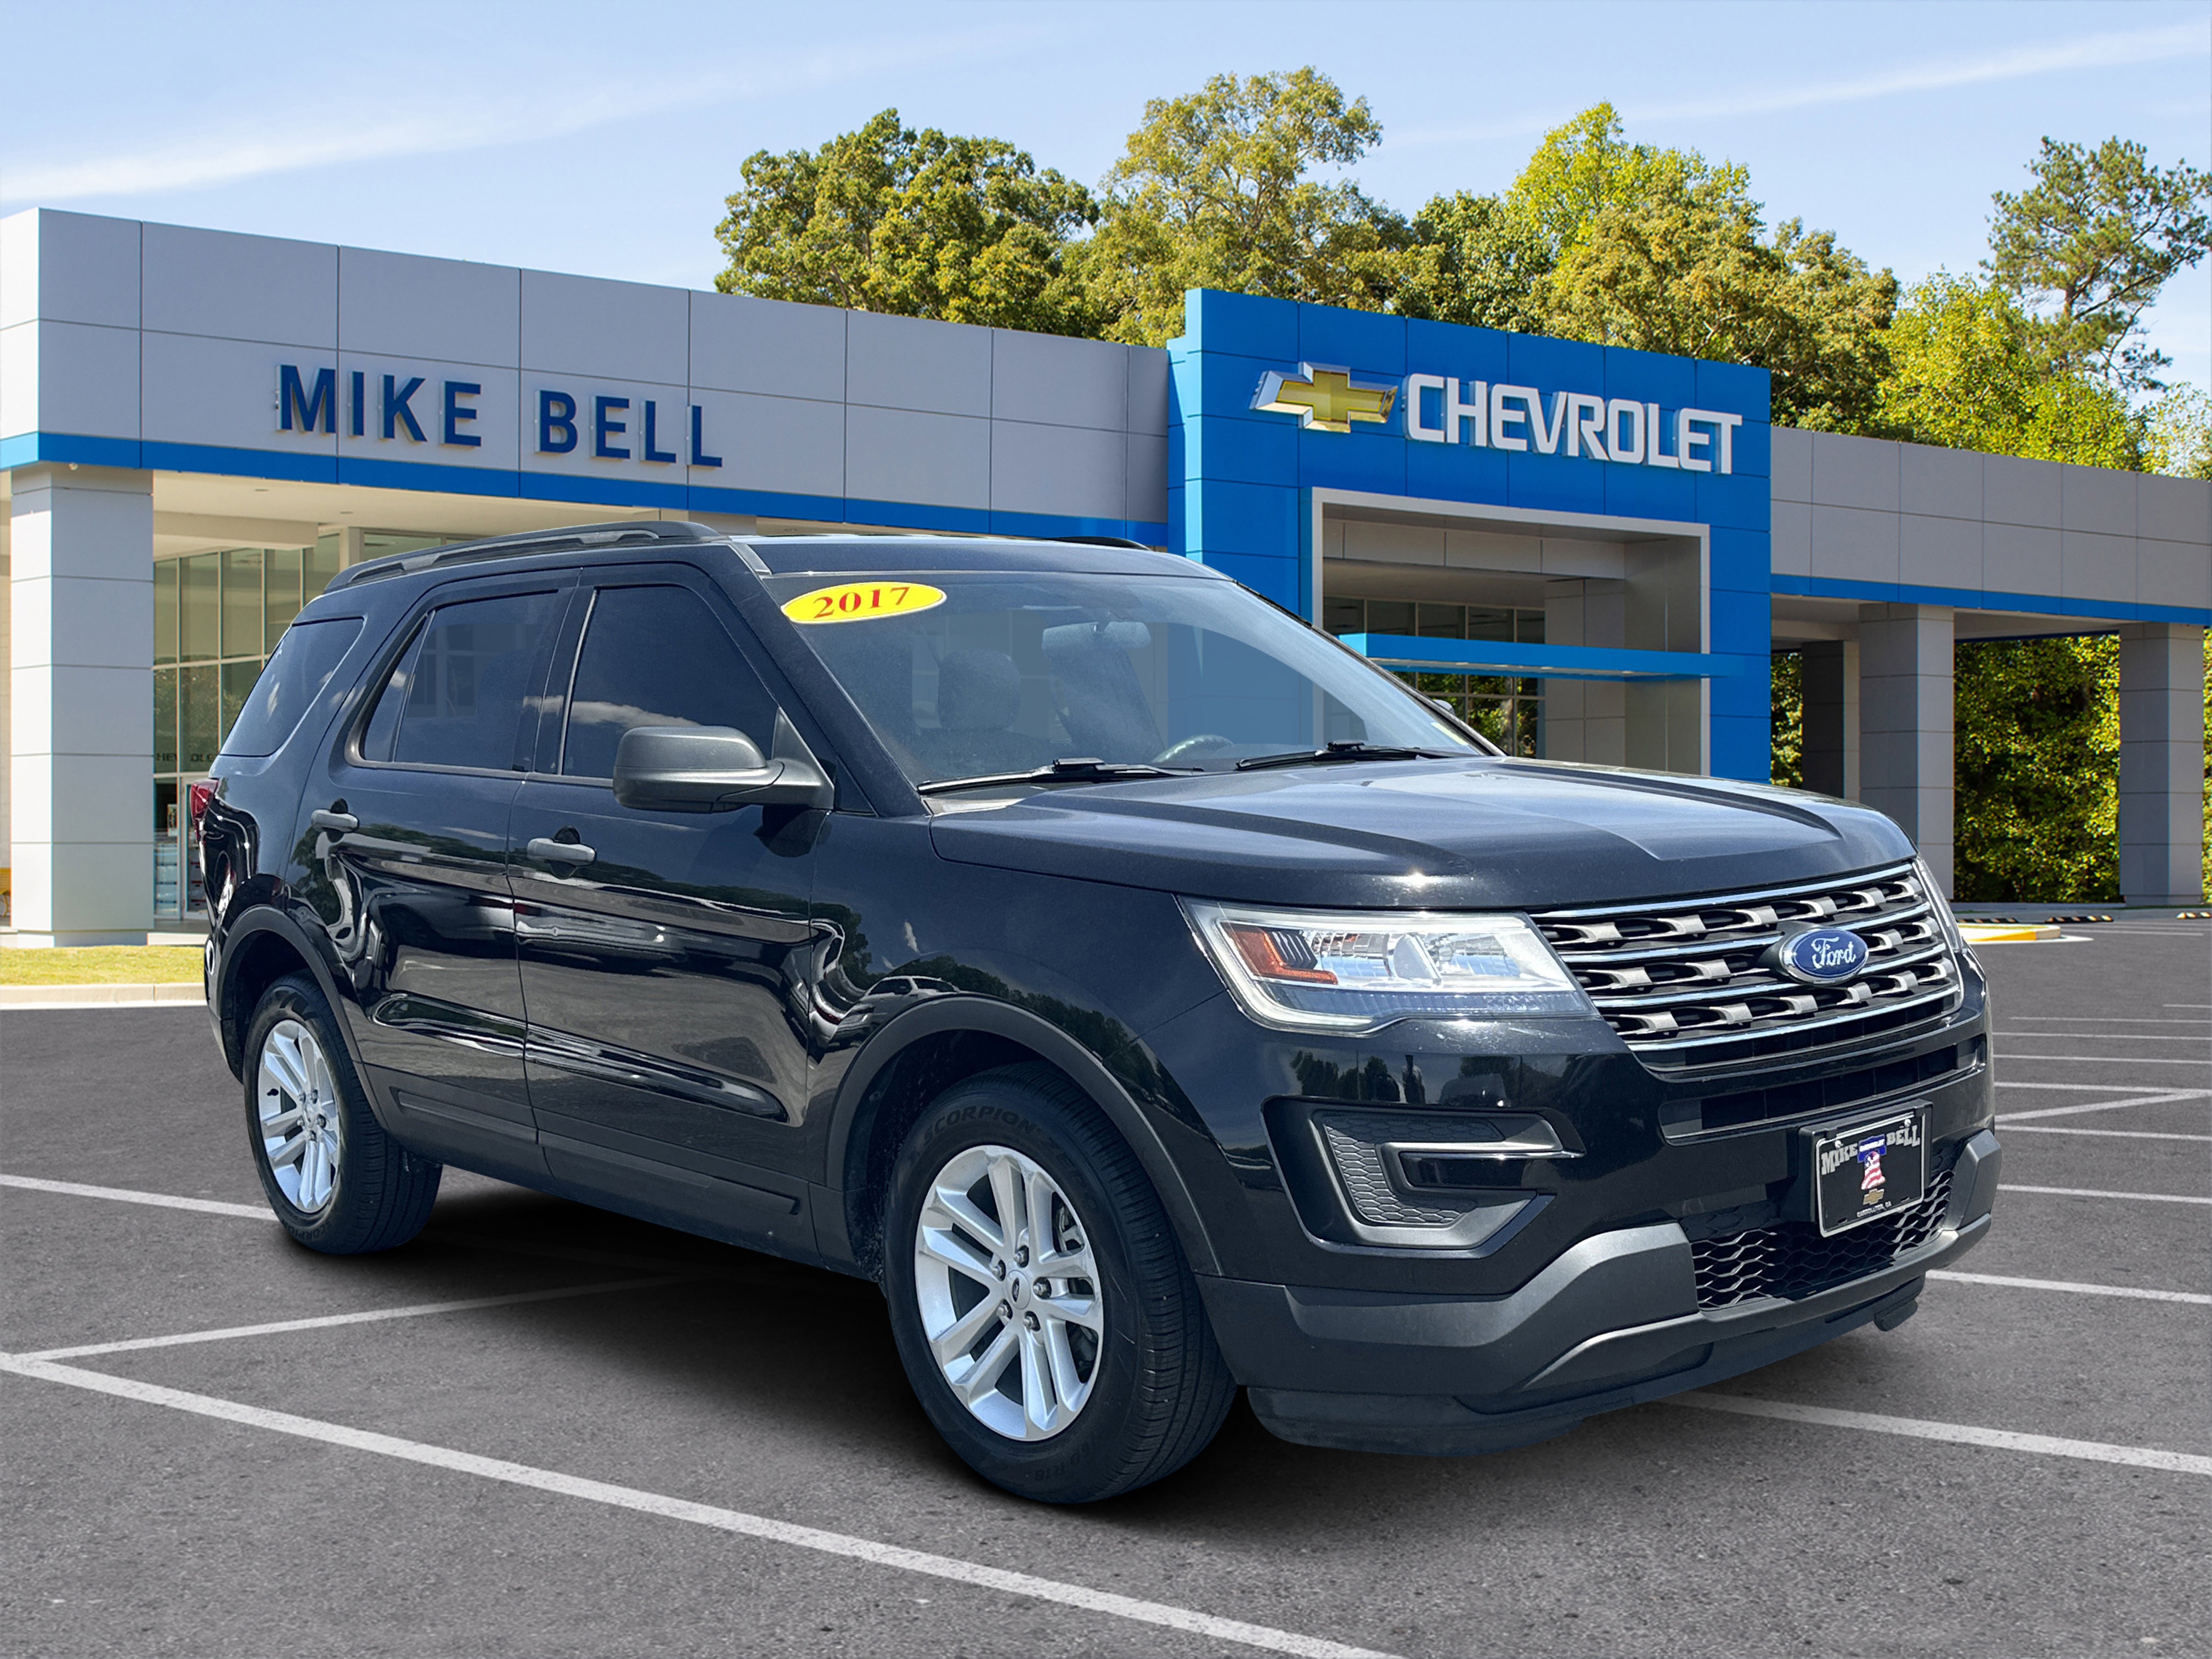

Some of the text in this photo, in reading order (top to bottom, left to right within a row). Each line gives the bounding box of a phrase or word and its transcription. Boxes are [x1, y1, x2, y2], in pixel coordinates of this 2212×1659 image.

[276, 364, 723, 468] MIKE BELL
[1403, 373, 1742, 474] CHEVROLET
[813, 586, 910, 618] 2017
[1812, 936, 1857, 969] Ford
[924, 1105, 1037, 1145] SCORPION
[1821, 1143, 1858, 1175] MIKE
[1886, 1125, 1921, 1147] BELL
